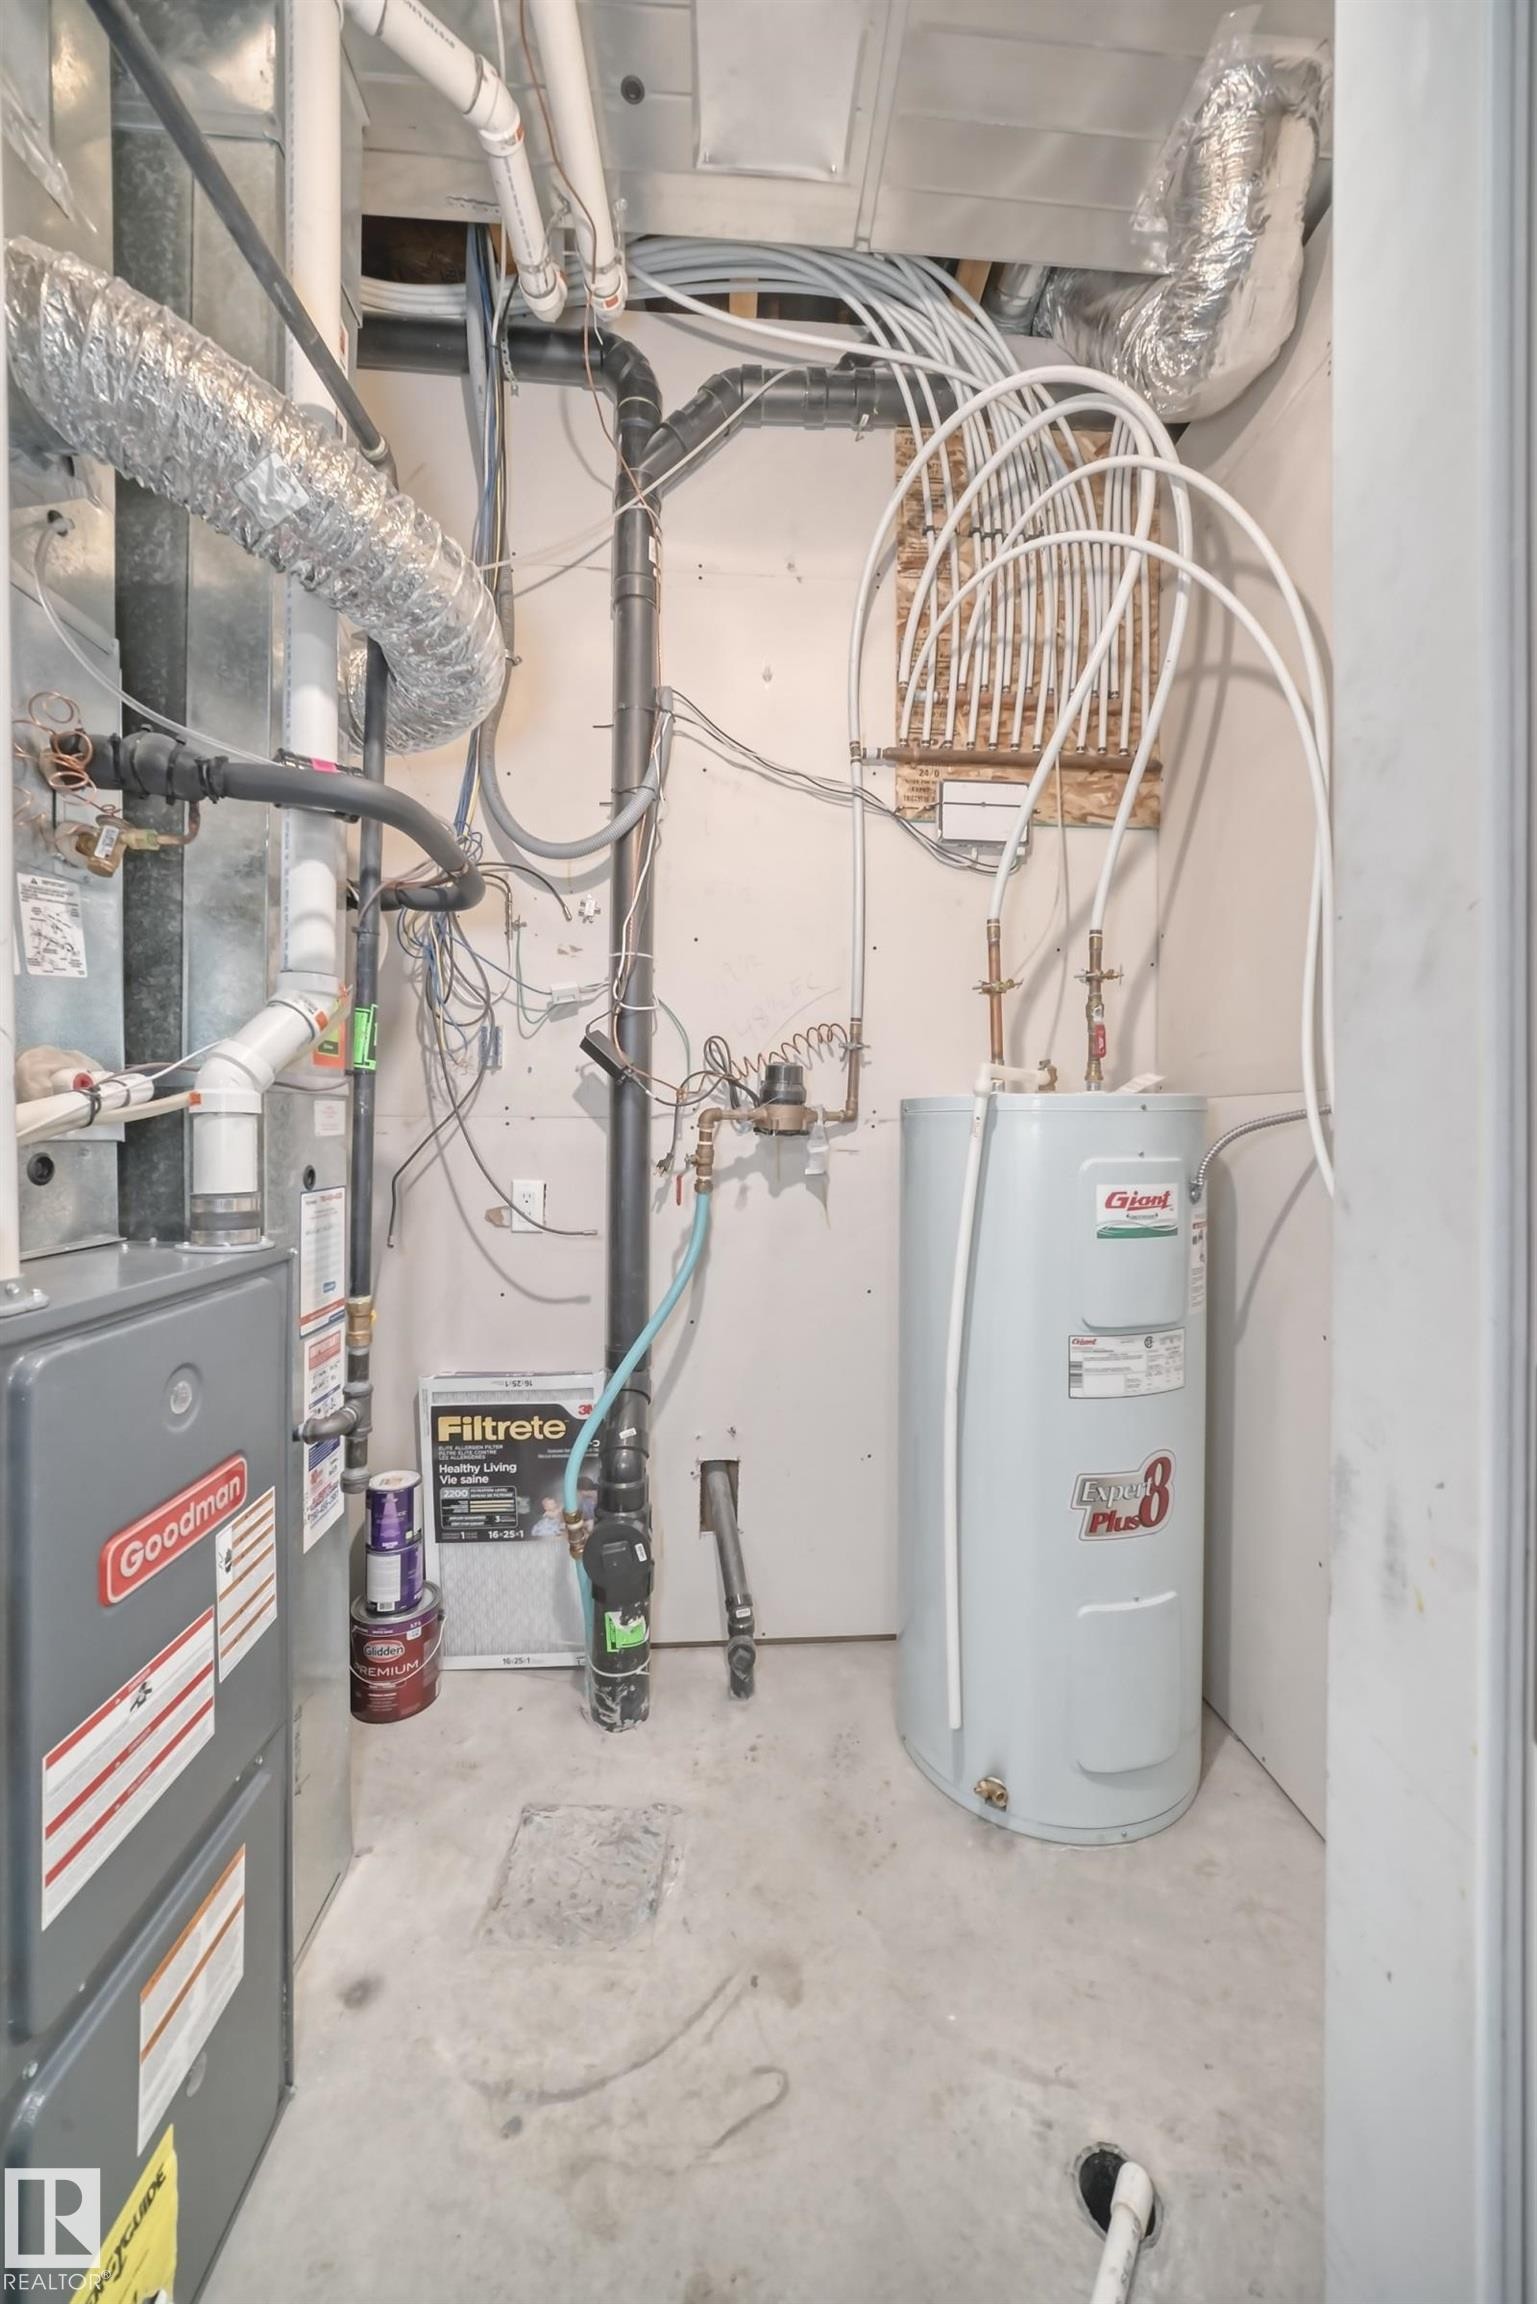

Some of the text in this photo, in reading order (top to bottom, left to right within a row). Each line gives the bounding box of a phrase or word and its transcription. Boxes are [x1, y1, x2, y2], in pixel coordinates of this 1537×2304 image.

[1105, 1190, 1171, 1212] Giant
[438, 1415, 567, 1442] Filtrete
[439, 1462, 517, 1475] Healthy Living
[439, 1474, 489, 1485] Vie saine
[443, 1489, 469, 1498] 2200
[1081, 1476, 1153, 1508] Expert
[1088, 1456, 1172, 1533] Plus 8
[119, 1475, 241, 1578] Goodman
[364, 1646, 404, 1657] Glidden
[353, 1659, 419, 1677] PREMIUM
